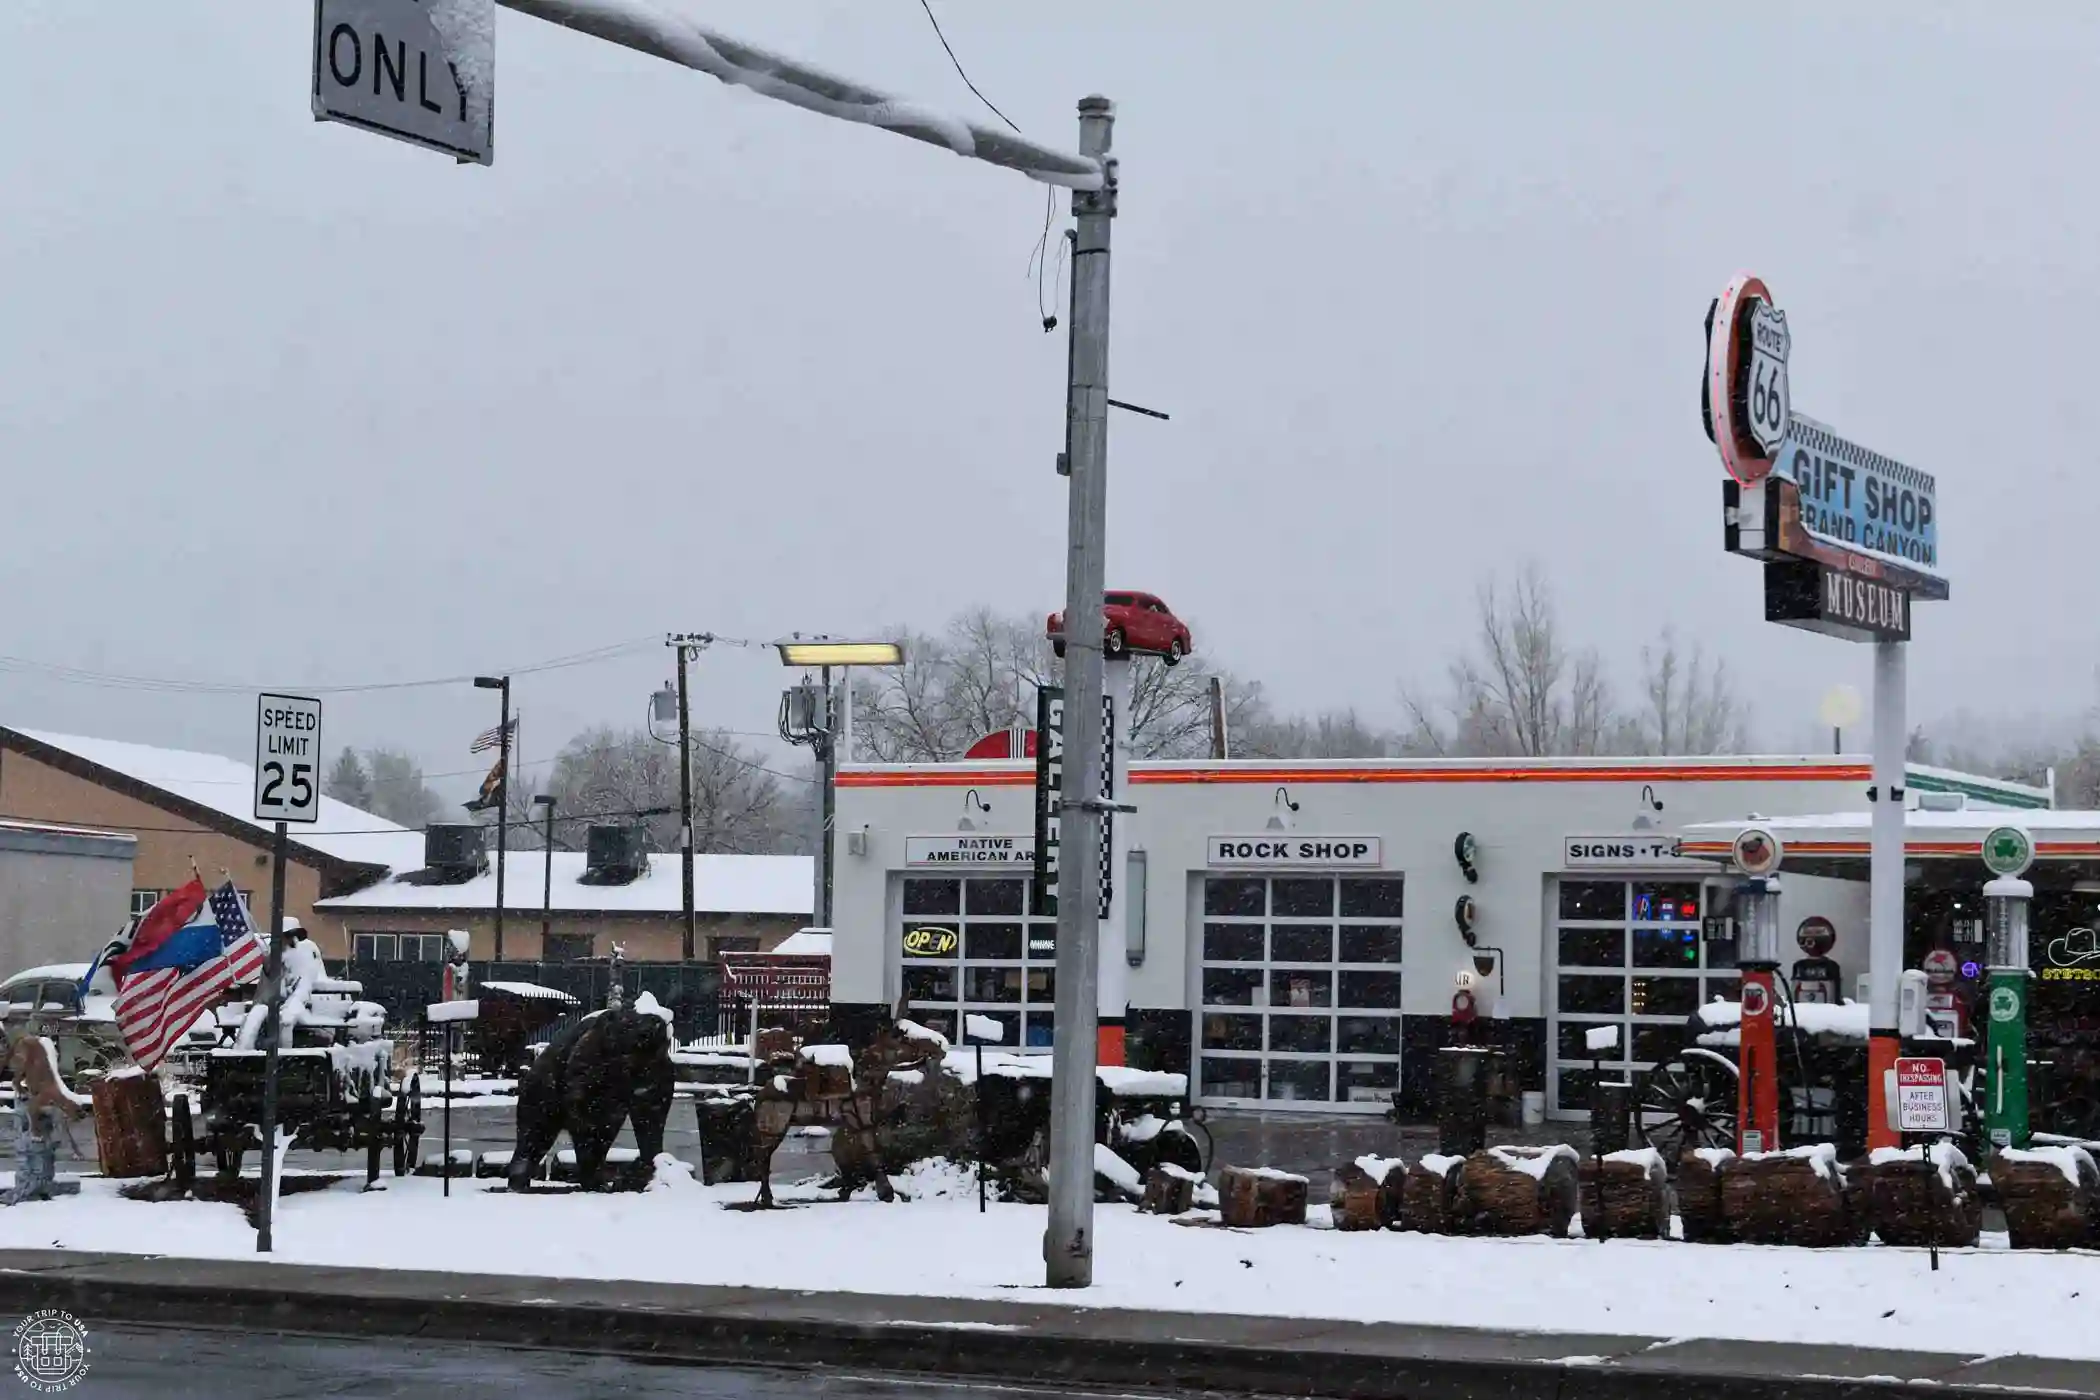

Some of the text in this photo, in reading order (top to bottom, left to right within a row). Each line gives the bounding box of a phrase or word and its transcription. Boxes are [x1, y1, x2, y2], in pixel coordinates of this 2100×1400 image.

[329, 23, 470, 122] ONLY
[1757, 322, 1782, 352] ROUTE
[1754, 360, 1780, 431] 66
[1793, 448, 1932, 535] GIFT SHOP
[1800, 503, 1932, 565] RAND CANYON
[1826, 572, 1904, 631] MUSEUM
[263, 708, 316, 731] SPEED
[268, 734, 309, 756] LIMIT
[261, 761, 313, 808] 25
[958, 839, 1013, 849] NATIVE
[1219, 843, 1368, 858] ROCK SHOP
[1569, 844, 1635, 858] SIGNS
[927, 851, 1008, 861] AMERICAN
[906, 930, 952, 952] OPEN
[1912, 1063, 1927, 1073] NO
[1903, 1102, 1943, 1112] BUSINESS
[1909, 1091, 1934, 1101] AFTER
[1909, 1113, 1937, 1122] HOURS
